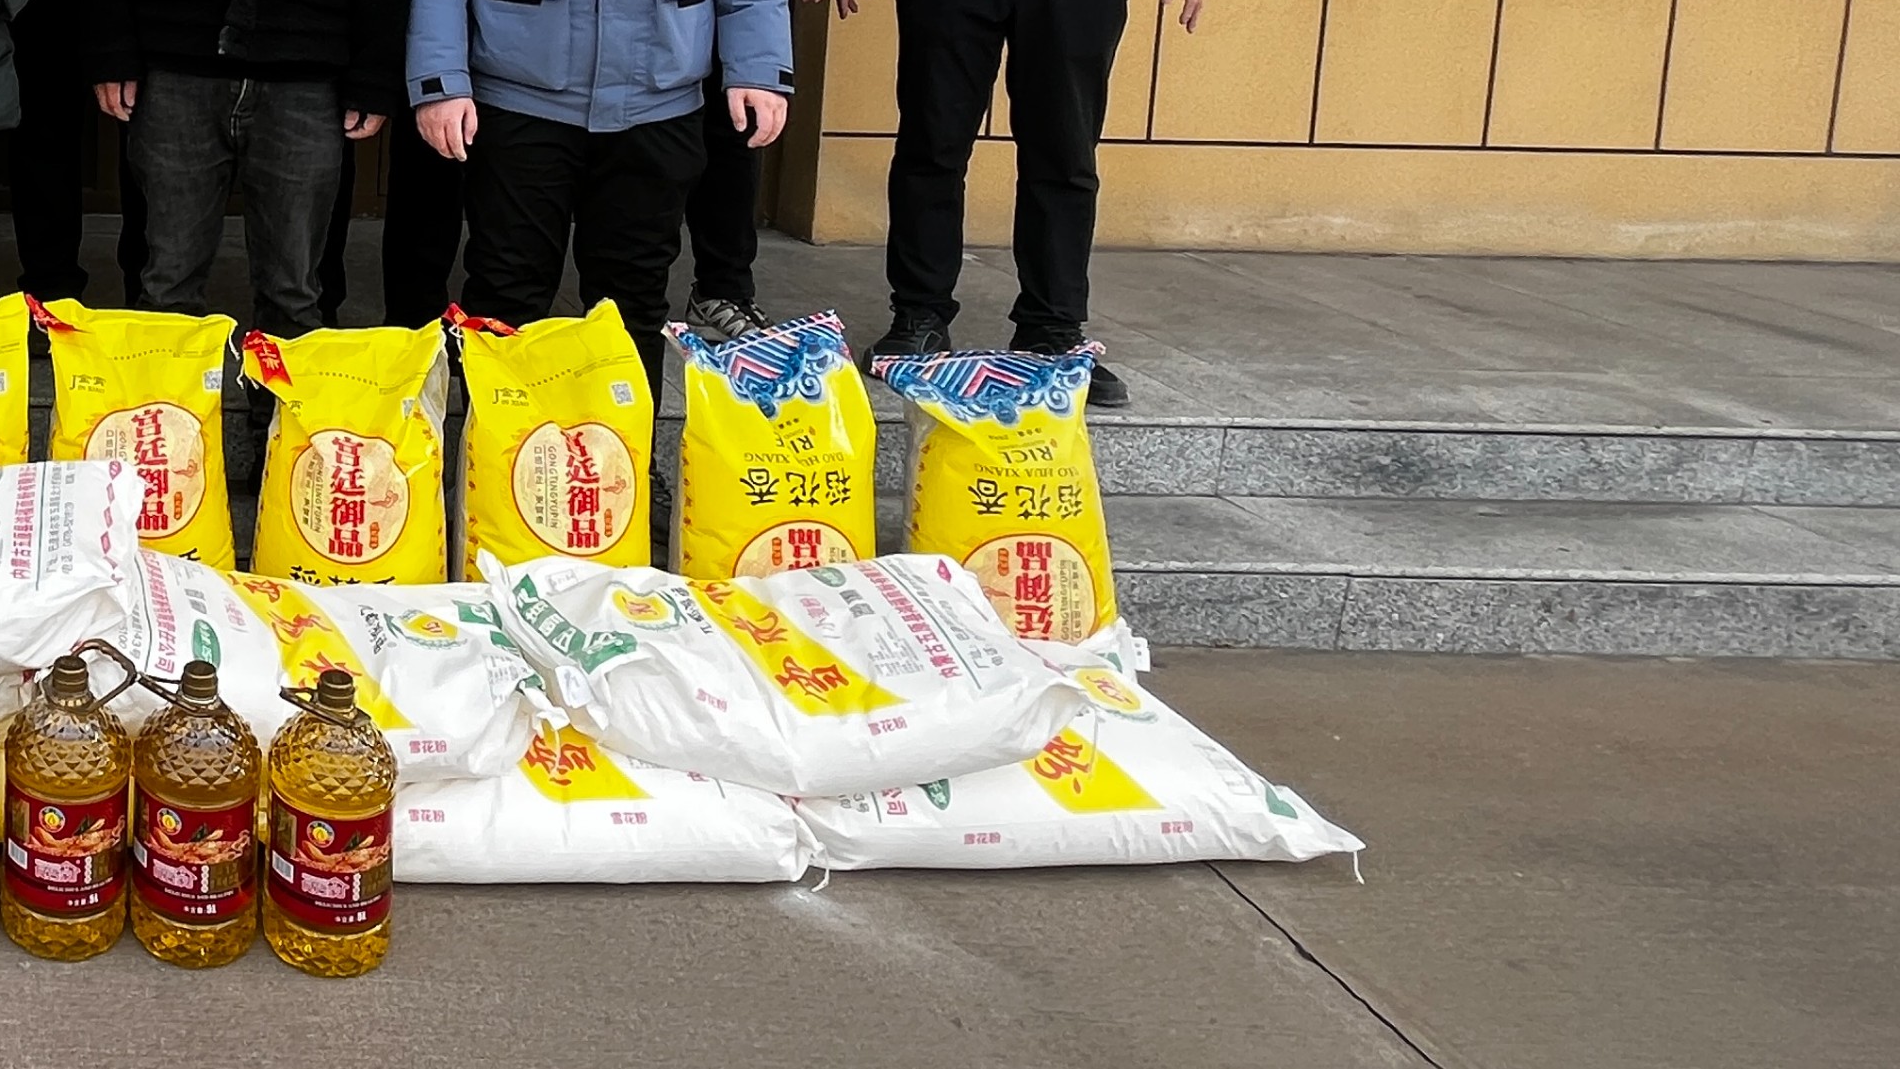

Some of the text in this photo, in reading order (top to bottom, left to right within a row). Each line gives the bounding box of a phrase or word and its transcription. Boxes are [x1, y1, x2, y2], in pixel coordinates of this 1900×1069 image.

[744, 453, 790, 464] XIANG
[328, 437, 366, 558] 宫廷御品
[739, 468, 851, 507] 稻花香
[968, 478, 1083, 520] 稻花香
[409, 740, 448, 756] 雪花粉
